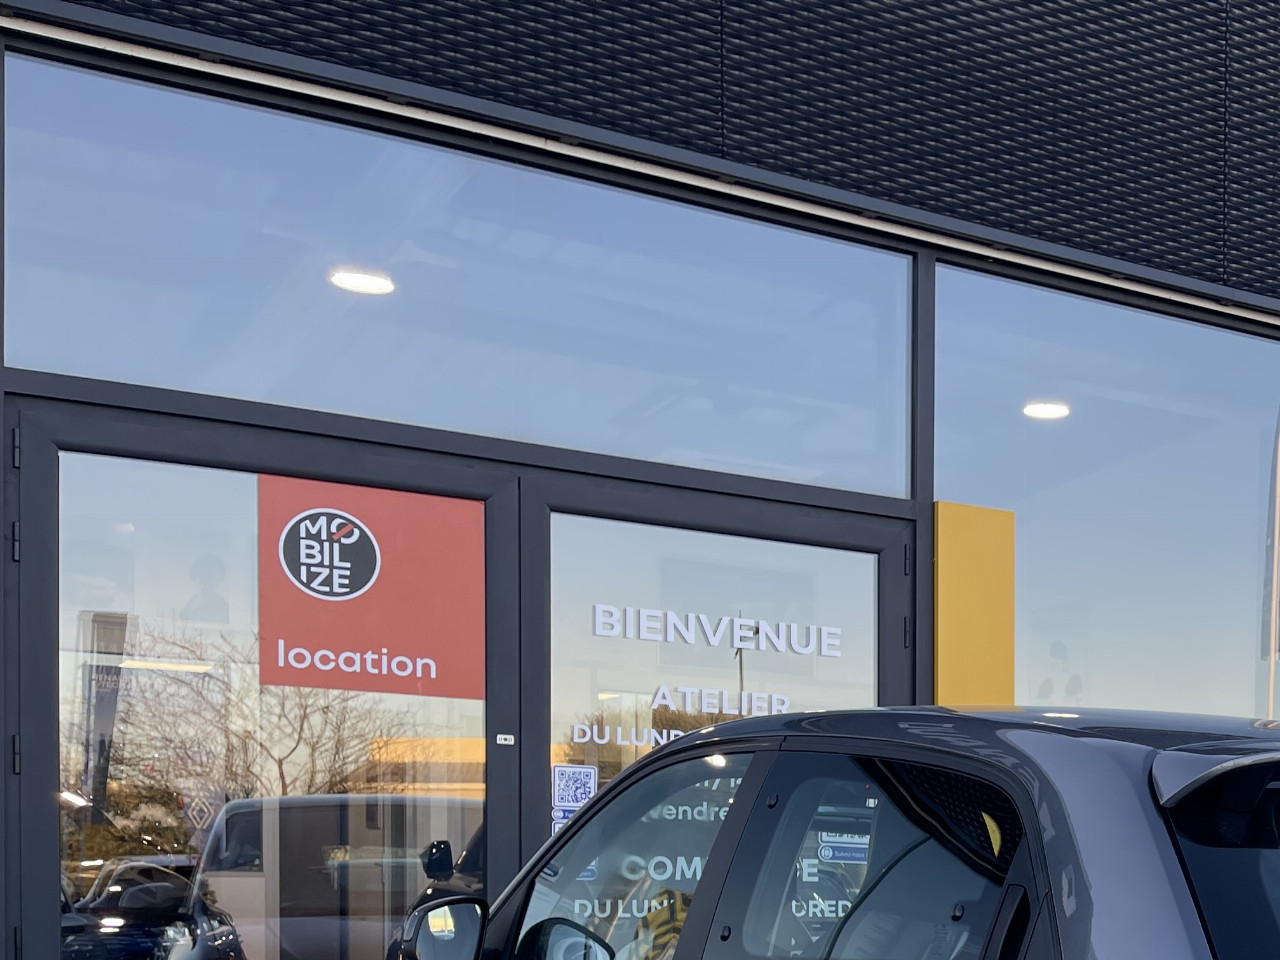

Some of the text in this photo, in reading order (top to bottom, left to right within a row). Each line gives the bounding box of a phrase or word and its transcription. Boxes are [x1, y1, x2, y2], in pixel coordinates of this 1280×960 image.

[593, 602, 843, 657] BIENVENUE
[277, 638, 437, 679] location
[651, 684, 791, 716] ATELIER
[572, 723, 689, 747] DU LUND
